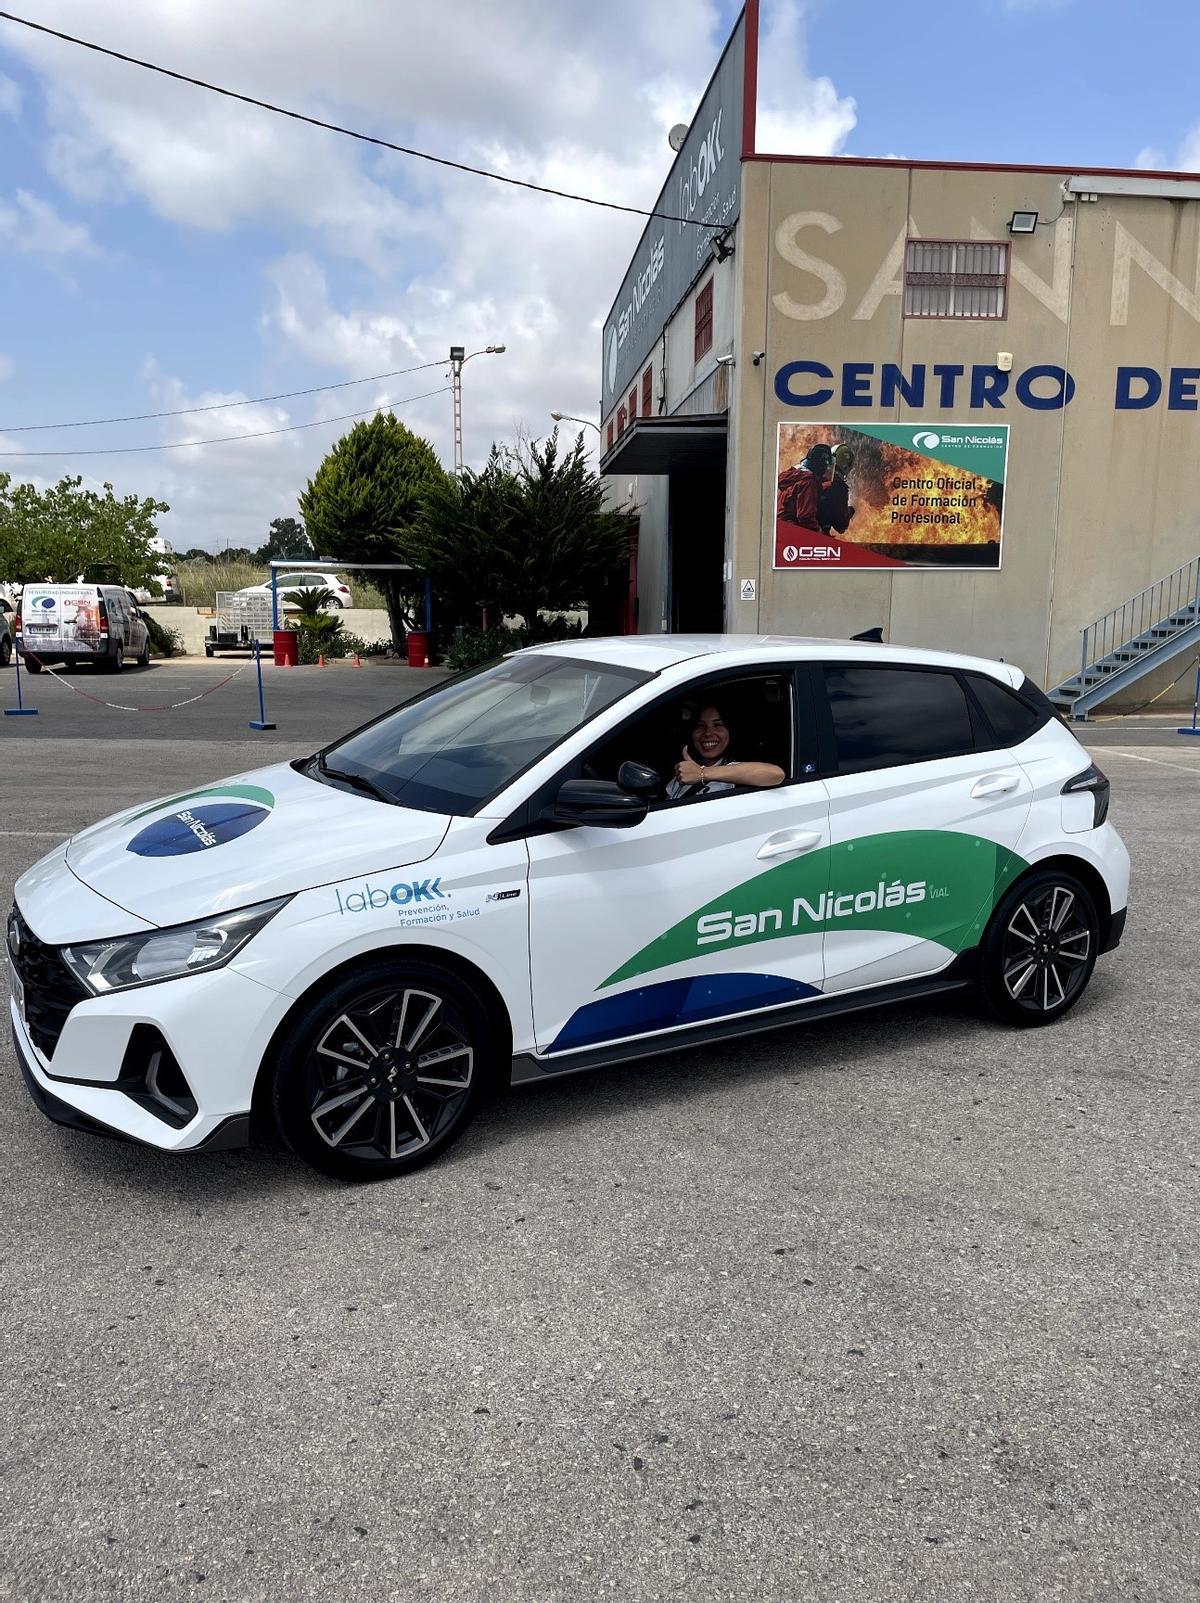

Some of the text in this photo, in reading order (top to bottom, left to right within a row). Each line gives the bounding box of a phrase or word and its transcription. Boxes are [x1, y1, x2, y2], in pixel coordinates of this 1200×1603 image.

[774, 360, 1200, 410] CENTRO DE
[941, 435, 1003, 444] San Nicolás
[893, 477, 976, 490] Centro Oficial
[892, 494, 976, 507] de Formación
[891, 511, 960, 524] Profesional
[799, 546, 841, 557] GSN
[398, 903, 450, 917] Prevención,
[697, 879, 950, 946] San Nicolás VIAL
[400, 913, 447, 927] Formación
[457, 907, 481, 919] Salud
